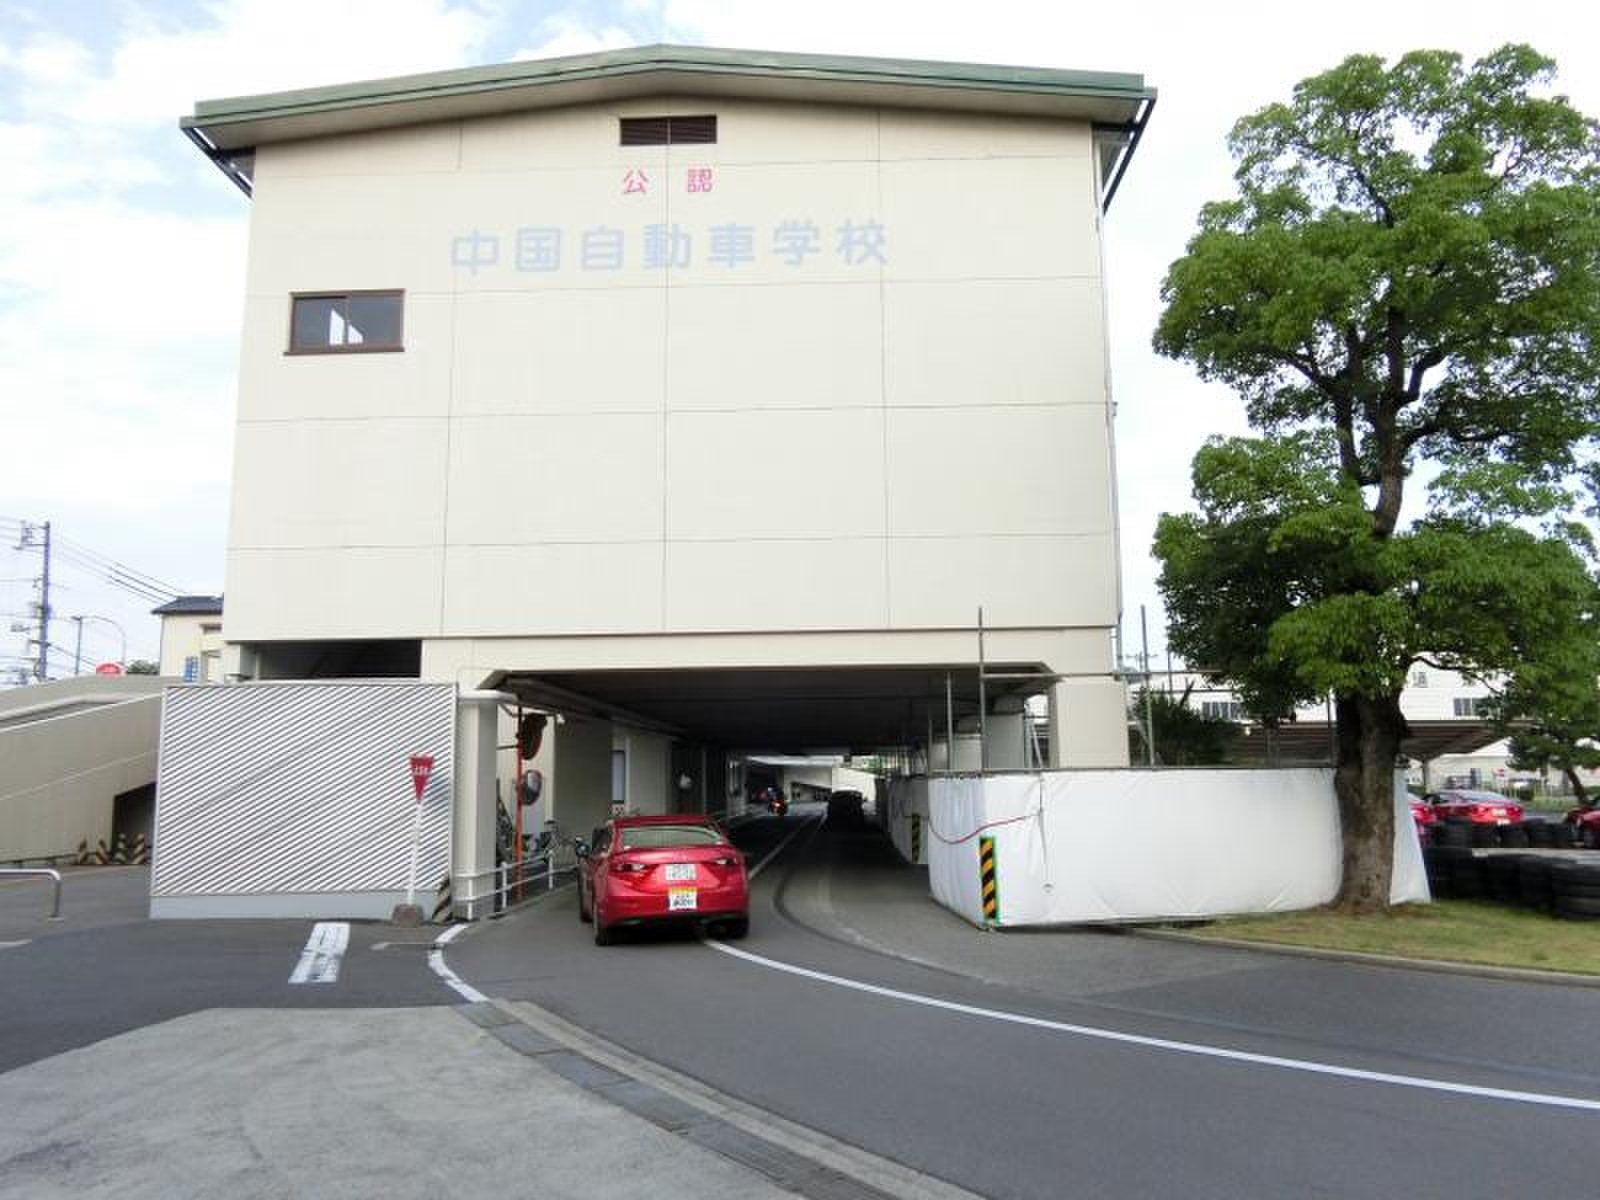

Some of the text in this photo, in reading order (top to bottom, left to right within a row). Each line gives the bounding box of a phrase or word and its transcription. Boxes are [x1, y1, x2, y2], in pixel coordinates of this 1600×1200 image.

[450, 218, 888, 276] 中国自動車学校
